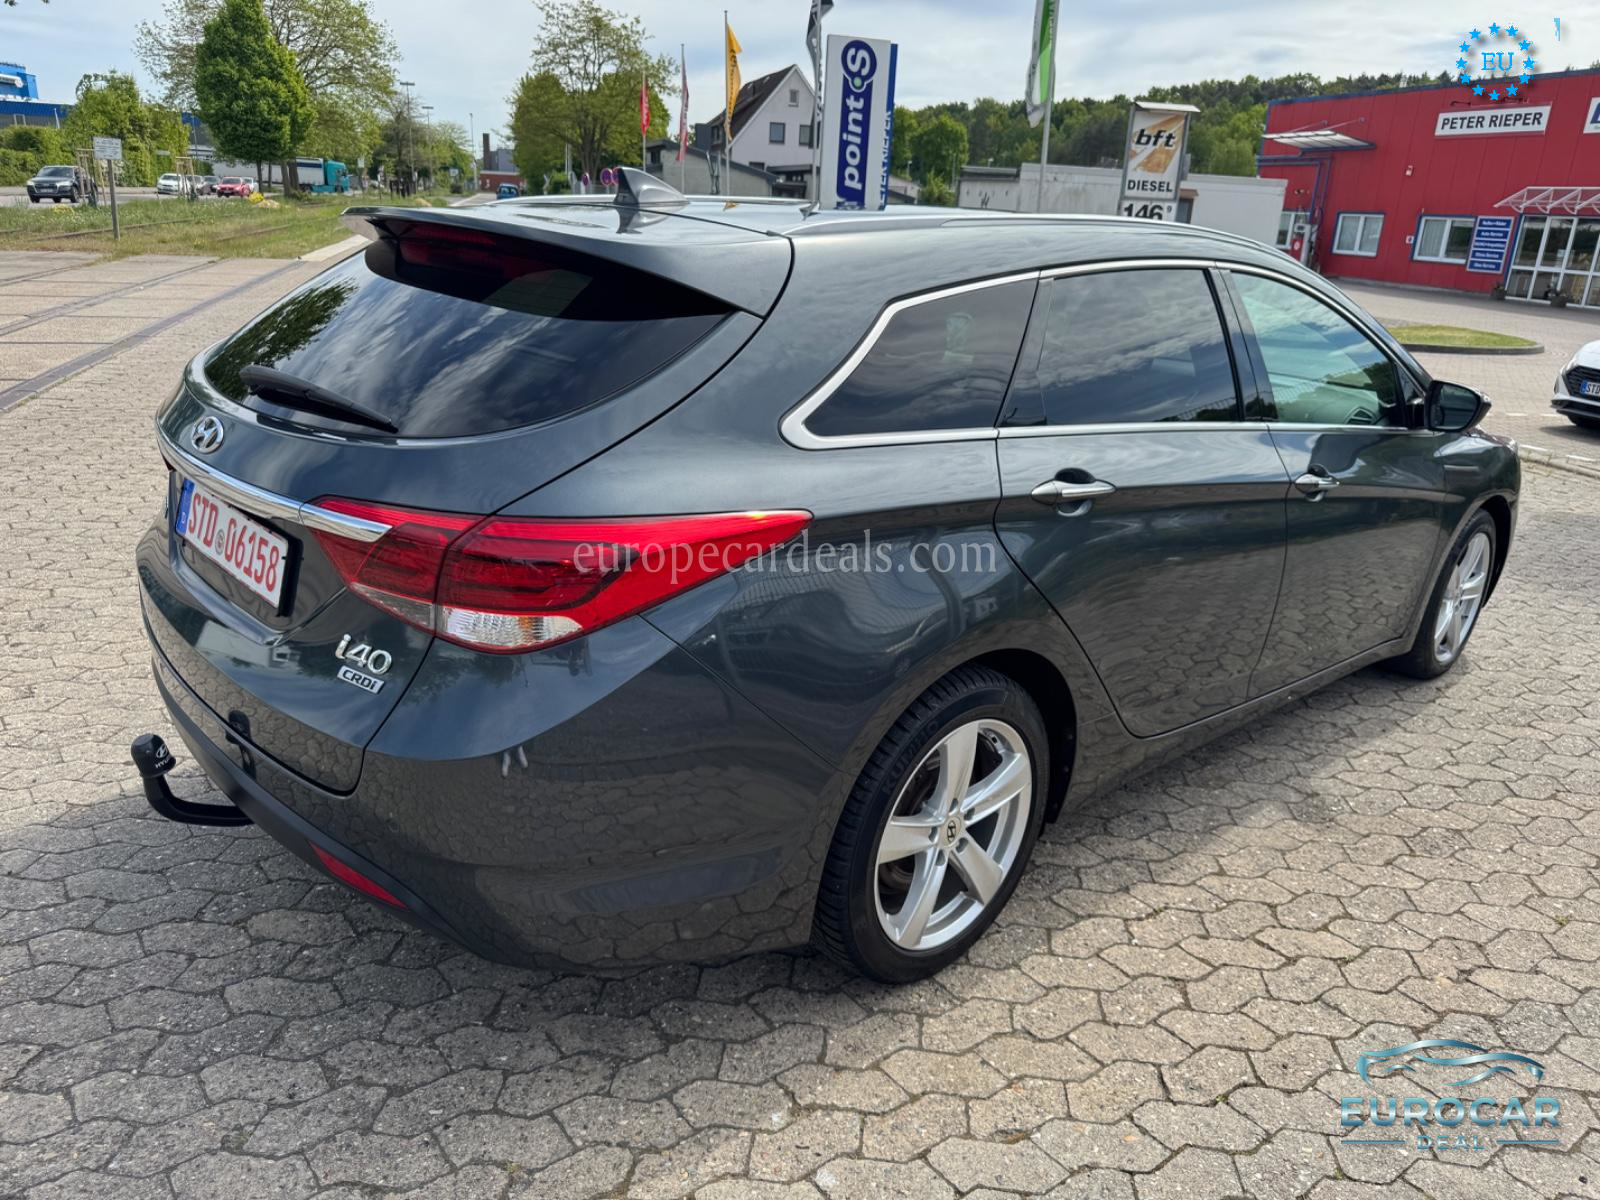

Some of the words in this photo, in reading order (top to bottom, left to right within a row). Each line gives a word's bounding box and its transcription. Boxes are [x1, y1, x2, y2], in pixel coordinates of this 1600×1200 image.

[1441, 116, 1485, 130] PETER
[1488, 112, 1543, 128] RIEPER
[843, 95, 865, 191] point
[1135, 128, 1176, 148] bft
[1127, 180, 1173, 193] DIESEL
[188, 492, 219, 548] STD
[224, 517, 280, 593] 06158
[335, 633, 393, 675] i40
